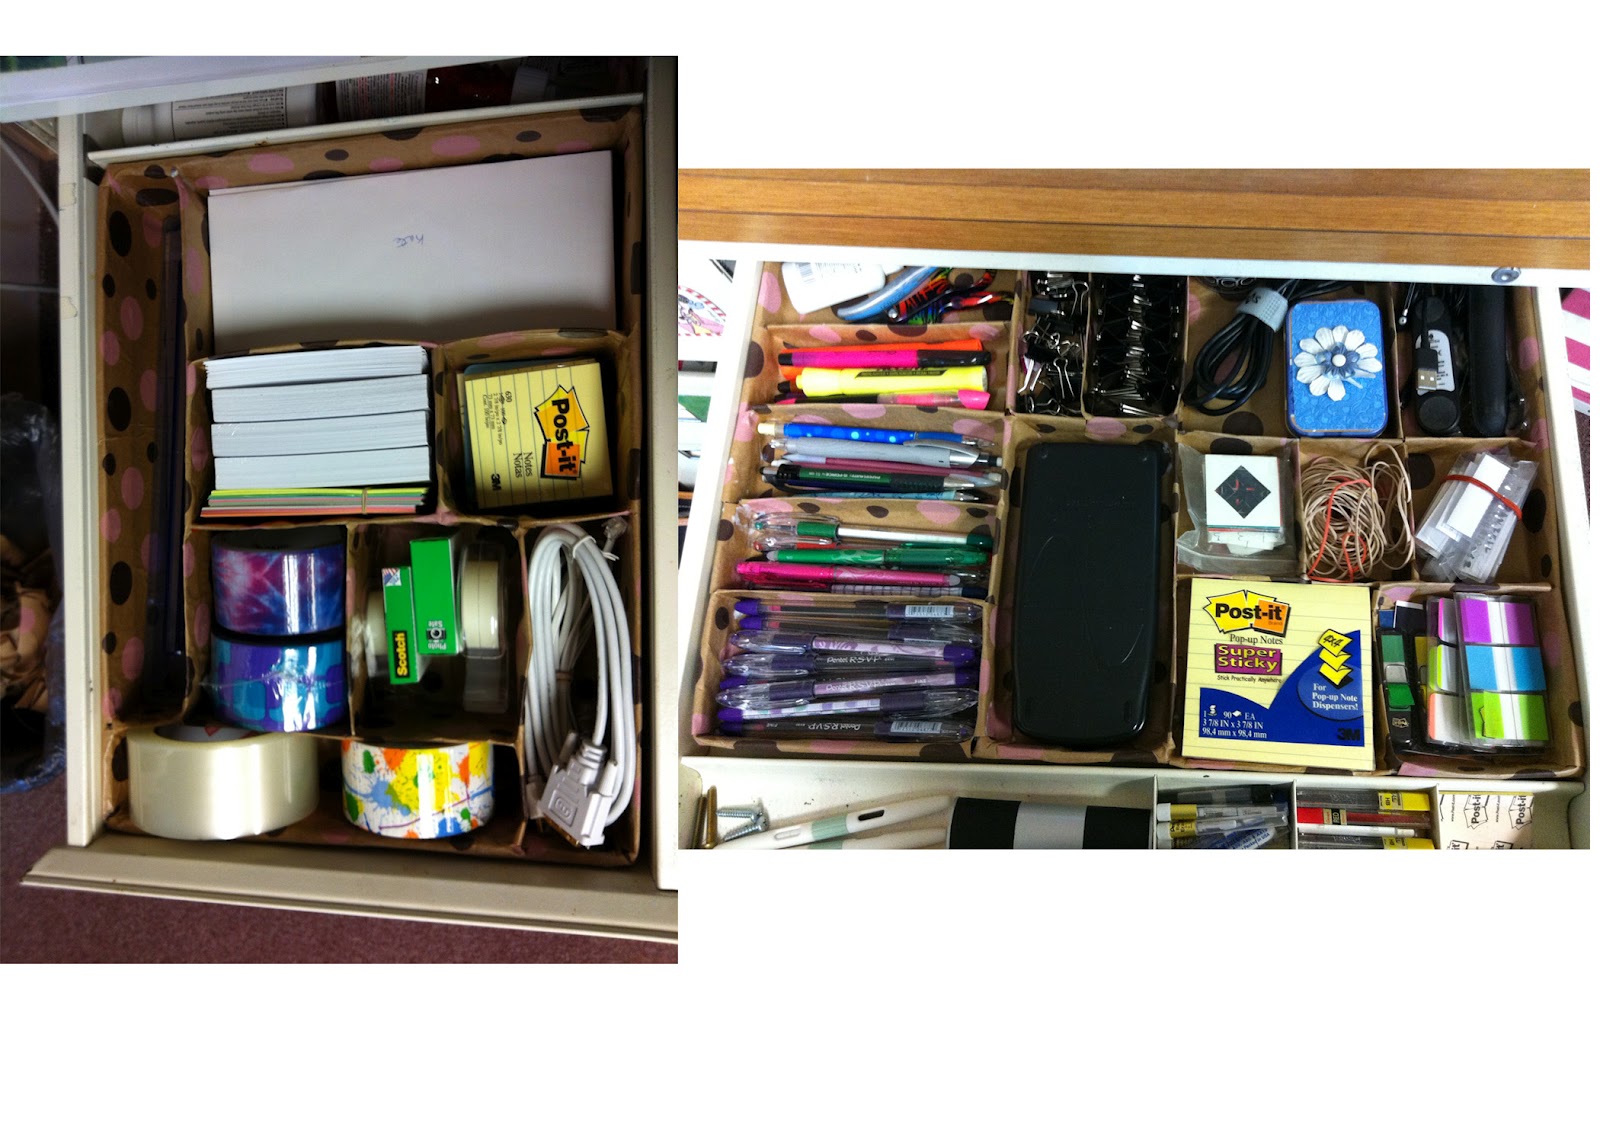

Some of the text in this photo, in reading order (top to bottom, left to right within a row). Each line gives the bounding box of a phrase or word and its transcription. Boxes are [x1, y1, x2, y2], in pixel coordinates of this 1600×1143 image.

[505, 391, 513, 402] 630
[552, 398, 577, 472] Post-it
[513, 453, 523, 478] Notas
[523, 451, 533, 477] Notes
[491, 473, 502, 491] 3M
[1215, 602, 1283, 621] Post-it
[428, 620, 443, 628] Safe
[1229, 633, 1284, 645] Pop-up Notes
[428, 641, 447, 650] Photo
[1217, 644, 1277, 658] Super
[395, 632, 408, 676] Scotch
[1217, 656, 1279, 673] Sticky
[1231, 675, 1256, 684] Practically
[1313, 683, 1327, 691] For
[1312, 692, 1358, 702] Pop-up Note
[1312, 701, 1359, 712] Dispensers!
[1223, 711, 1233, 719] 90
[1245, 712, 1256, 720] EA
[838, 722, 862, 731] Pentel
[1209, 719, 1219, 727] 7/8
[1237, 720, 1242, 728] 3
[1242, 720, 1253, 729] 7/8
[1254, 721, 1264, 729] IN
[1202, 727, 1217, 736] 98,4
[1238, 729, 1252, 738] 98,4
[1337, 728, 1361, 742] 3M
[1332, 812, 1340, 823] RED
